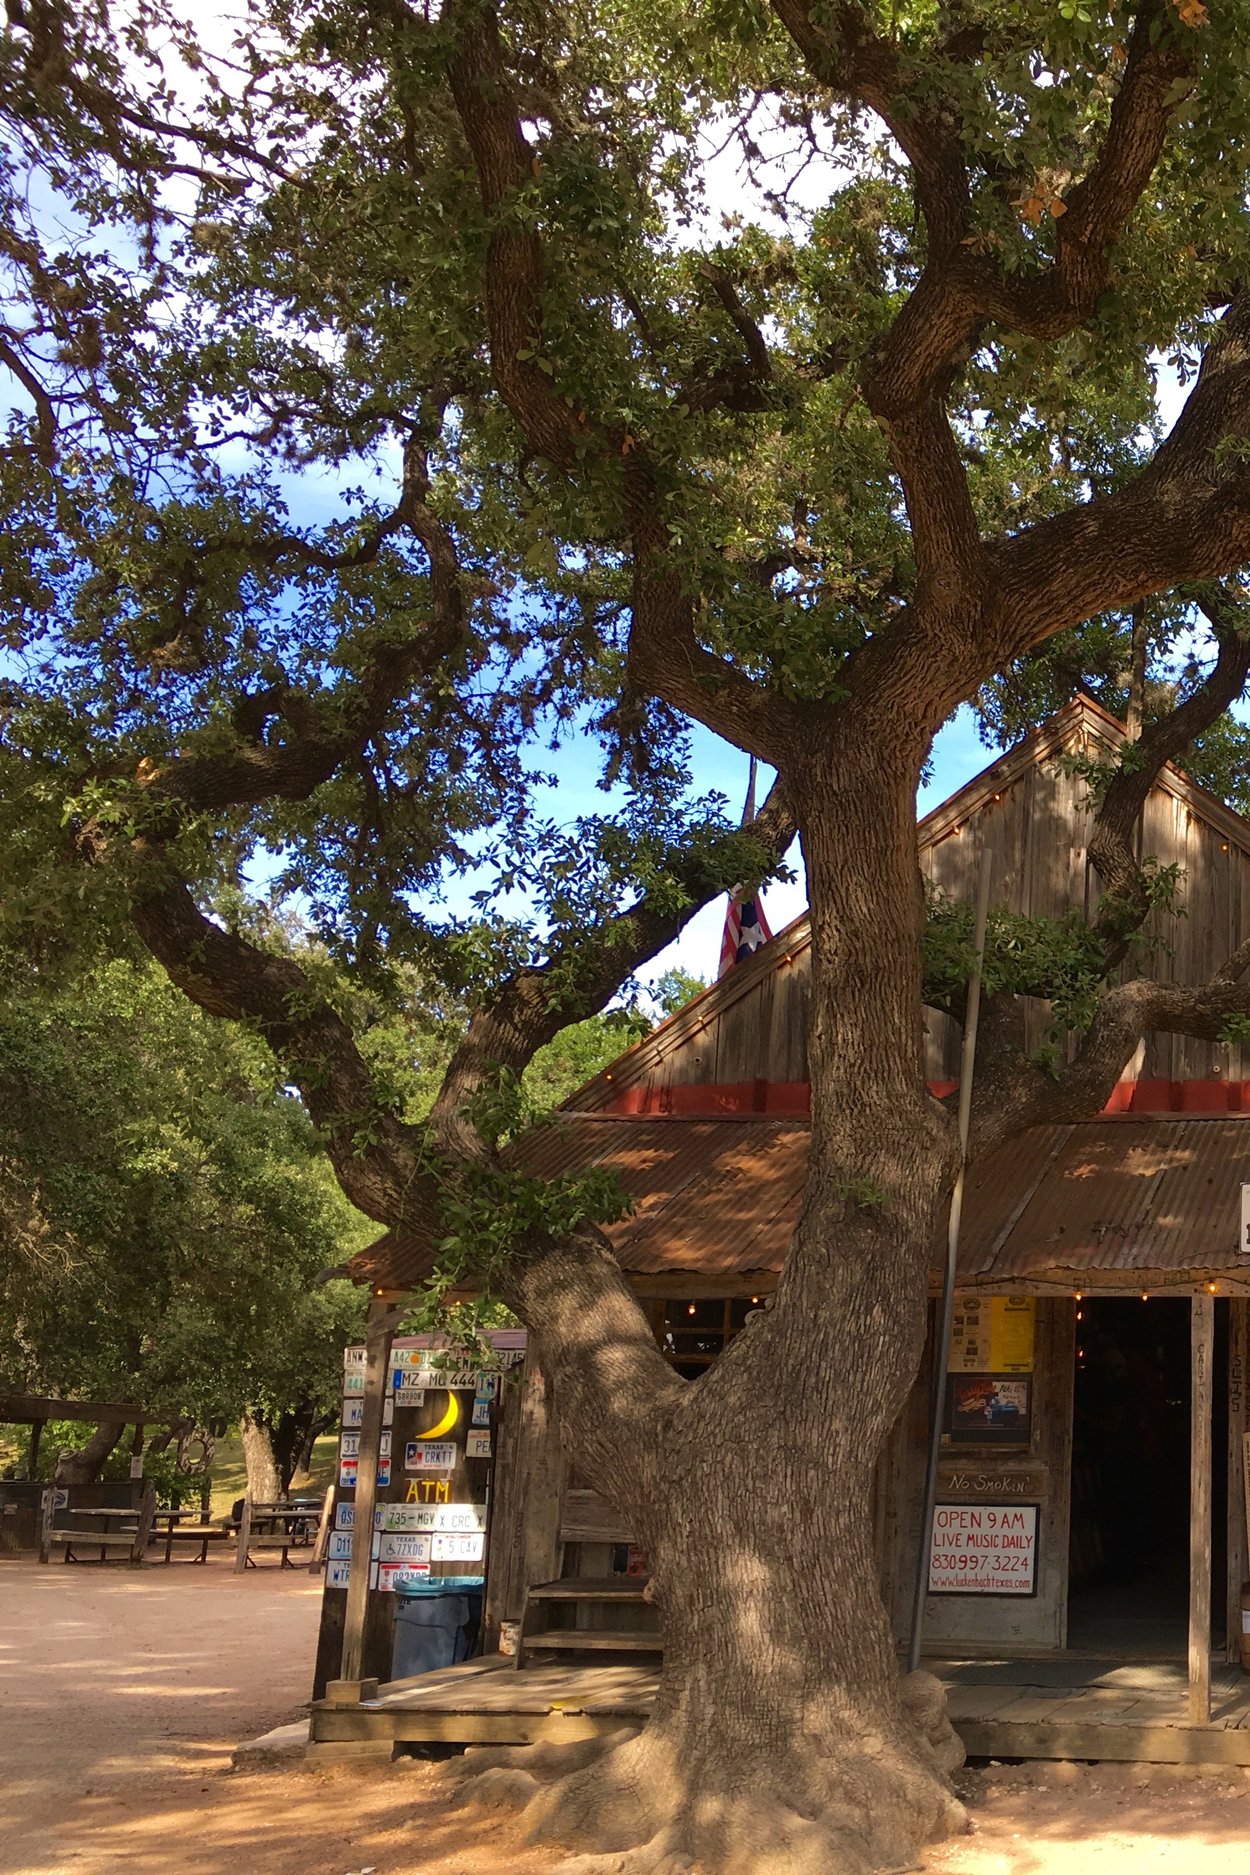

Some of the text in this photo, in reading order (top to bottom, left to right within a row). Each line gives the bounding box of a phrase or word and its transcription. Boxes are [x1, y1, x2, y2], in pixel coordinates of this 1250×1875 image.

[450, 1373, 475, 1387] 444
[948, 1474, 969, 1490] No
[405, 1481, 450, 1503] ATM
[938, 1511, 1025, 1529] OPEN 9 AM
[934, 1533, 1033, 1549] LIVE MUSIC DAILY
